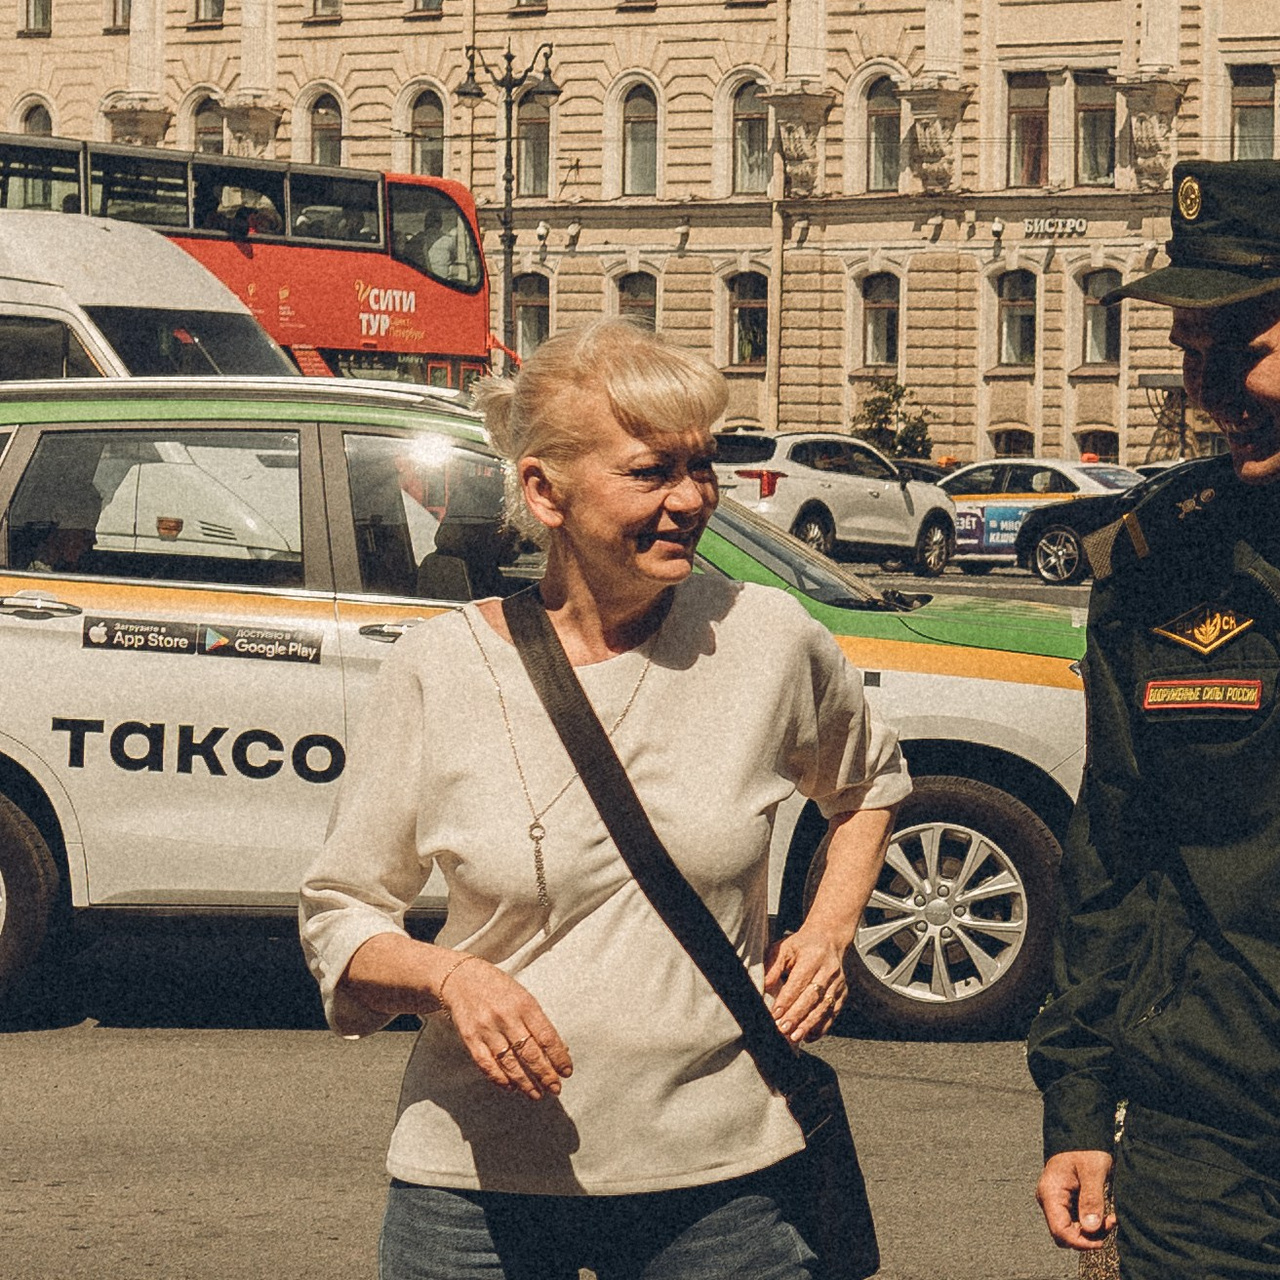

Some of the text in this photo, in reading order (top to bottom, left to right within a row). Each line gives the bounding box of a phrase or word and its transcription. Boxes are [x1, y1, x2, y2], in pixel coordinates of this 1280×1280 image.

[1023, 218, 1087, 233] БИСТРО
[369, 288, 416, 313] СИТИ
[359, 312, 390, 336] ТУР
[114, 622, 159, 632] Загрузите
[112, 631, 189, 649] App Store
[234, 638, 318, 660] Google Play
[1202, 686, 1225, 701] СИЛЫ
[1226, 687, 1258, 702] РОССИИ
